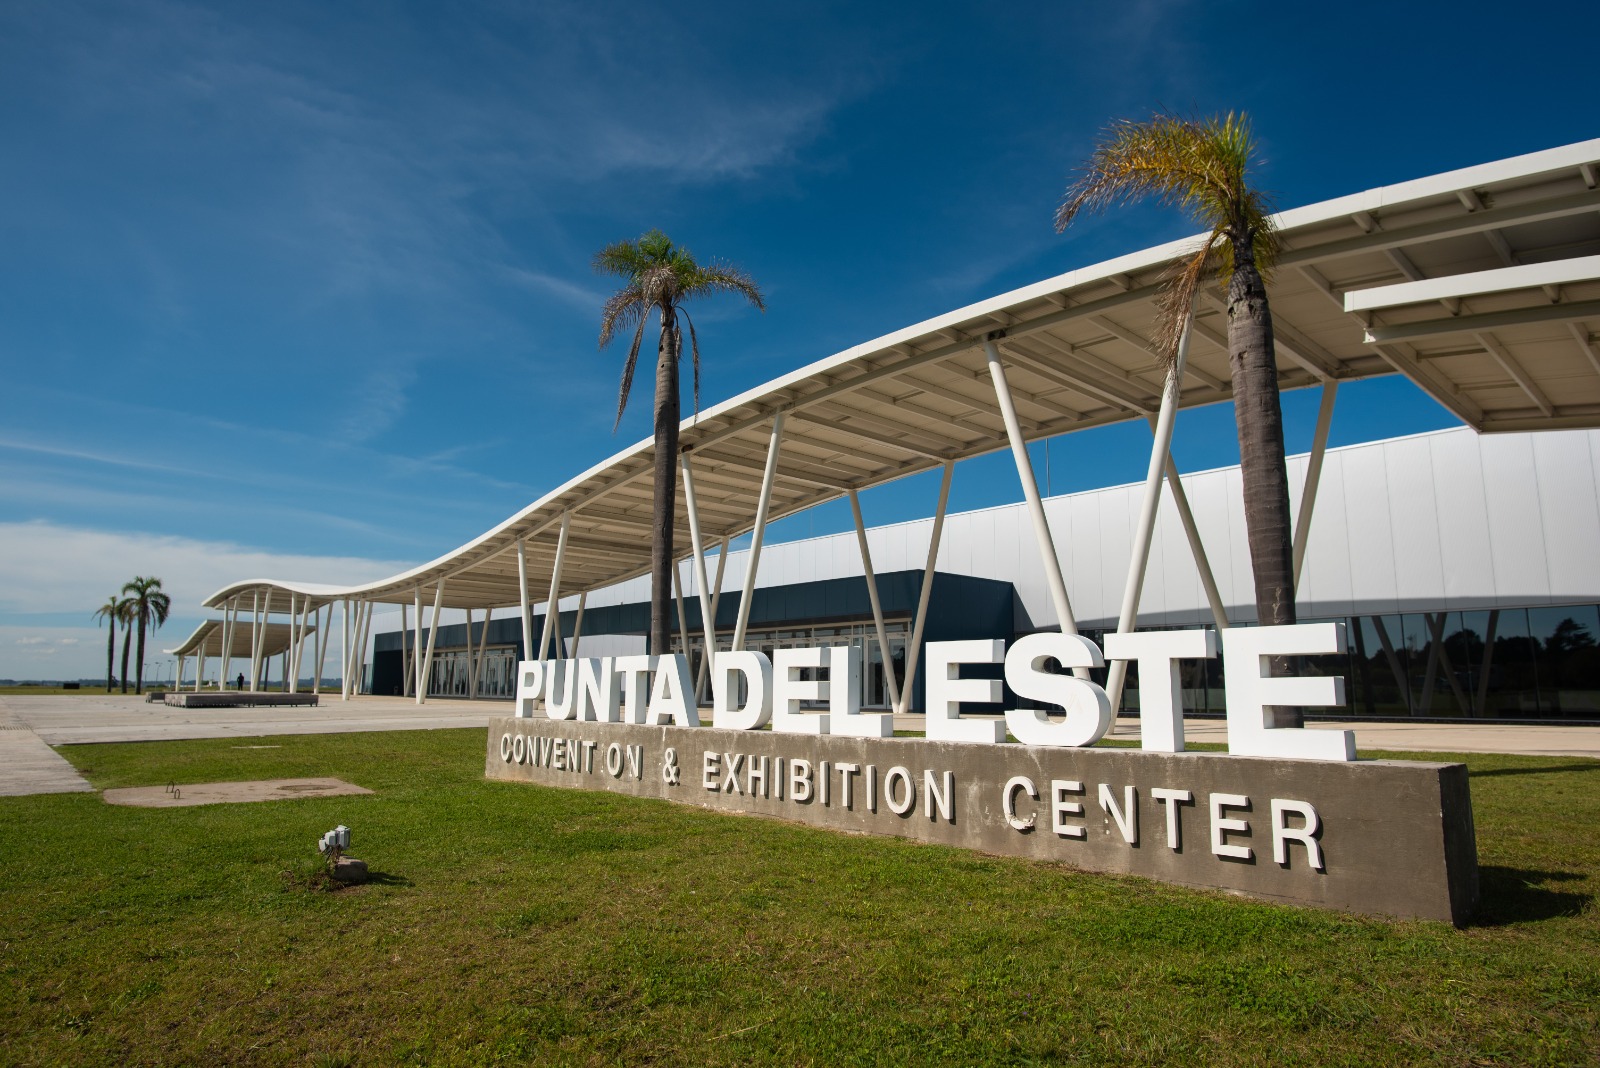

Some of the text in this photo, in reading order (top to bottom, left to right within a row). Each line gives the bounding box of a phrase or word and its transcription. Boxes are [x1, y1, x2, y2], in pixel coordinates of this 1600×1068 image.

[515, 622, 1357, 761] PUNTA DEL ESTE
[500, 733, 1323, 869] CONVENTON & EXHIBITION CENTER
